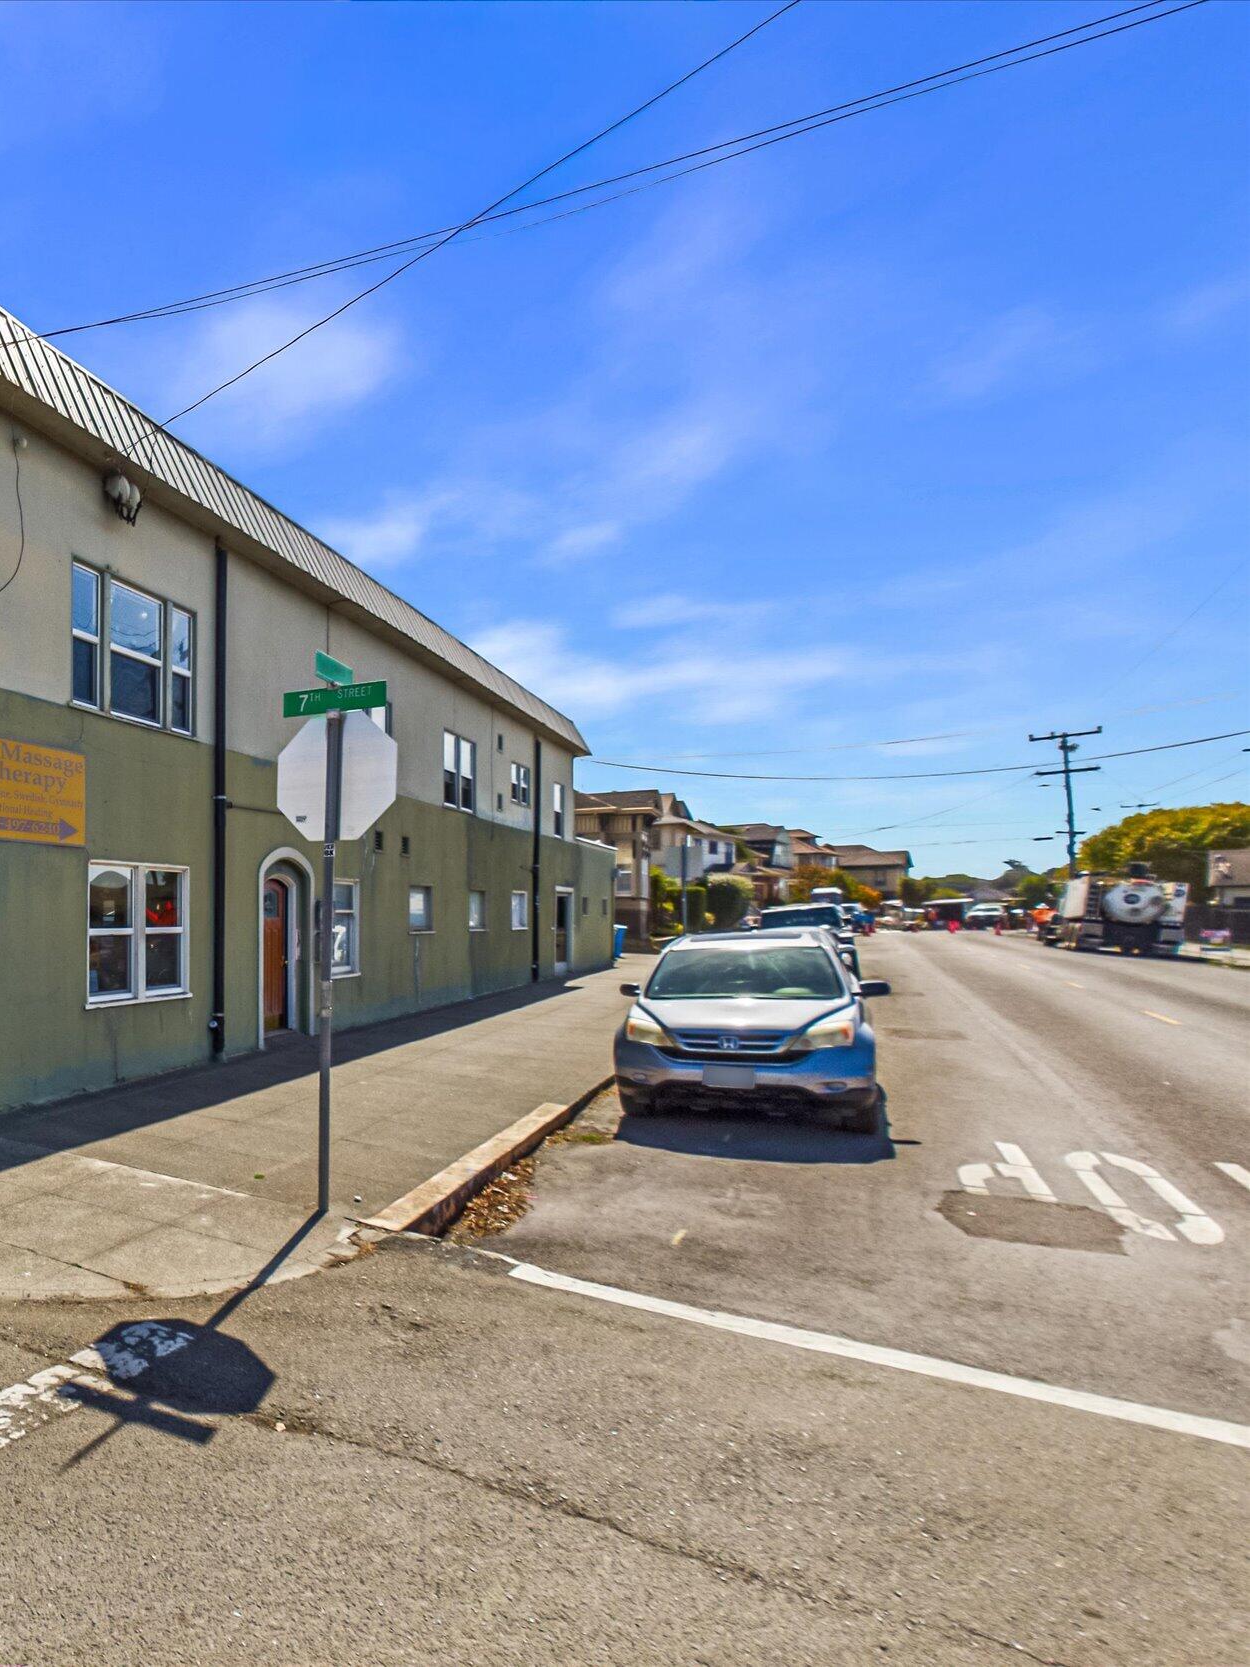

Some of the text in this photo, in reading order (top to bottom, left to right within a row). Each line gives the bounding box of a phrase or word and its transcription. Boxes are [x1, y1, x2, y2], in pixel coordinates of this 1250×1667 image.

[299, 685, 372, 712] 7TH STREET
[0, 740, 83, 777] Massage
